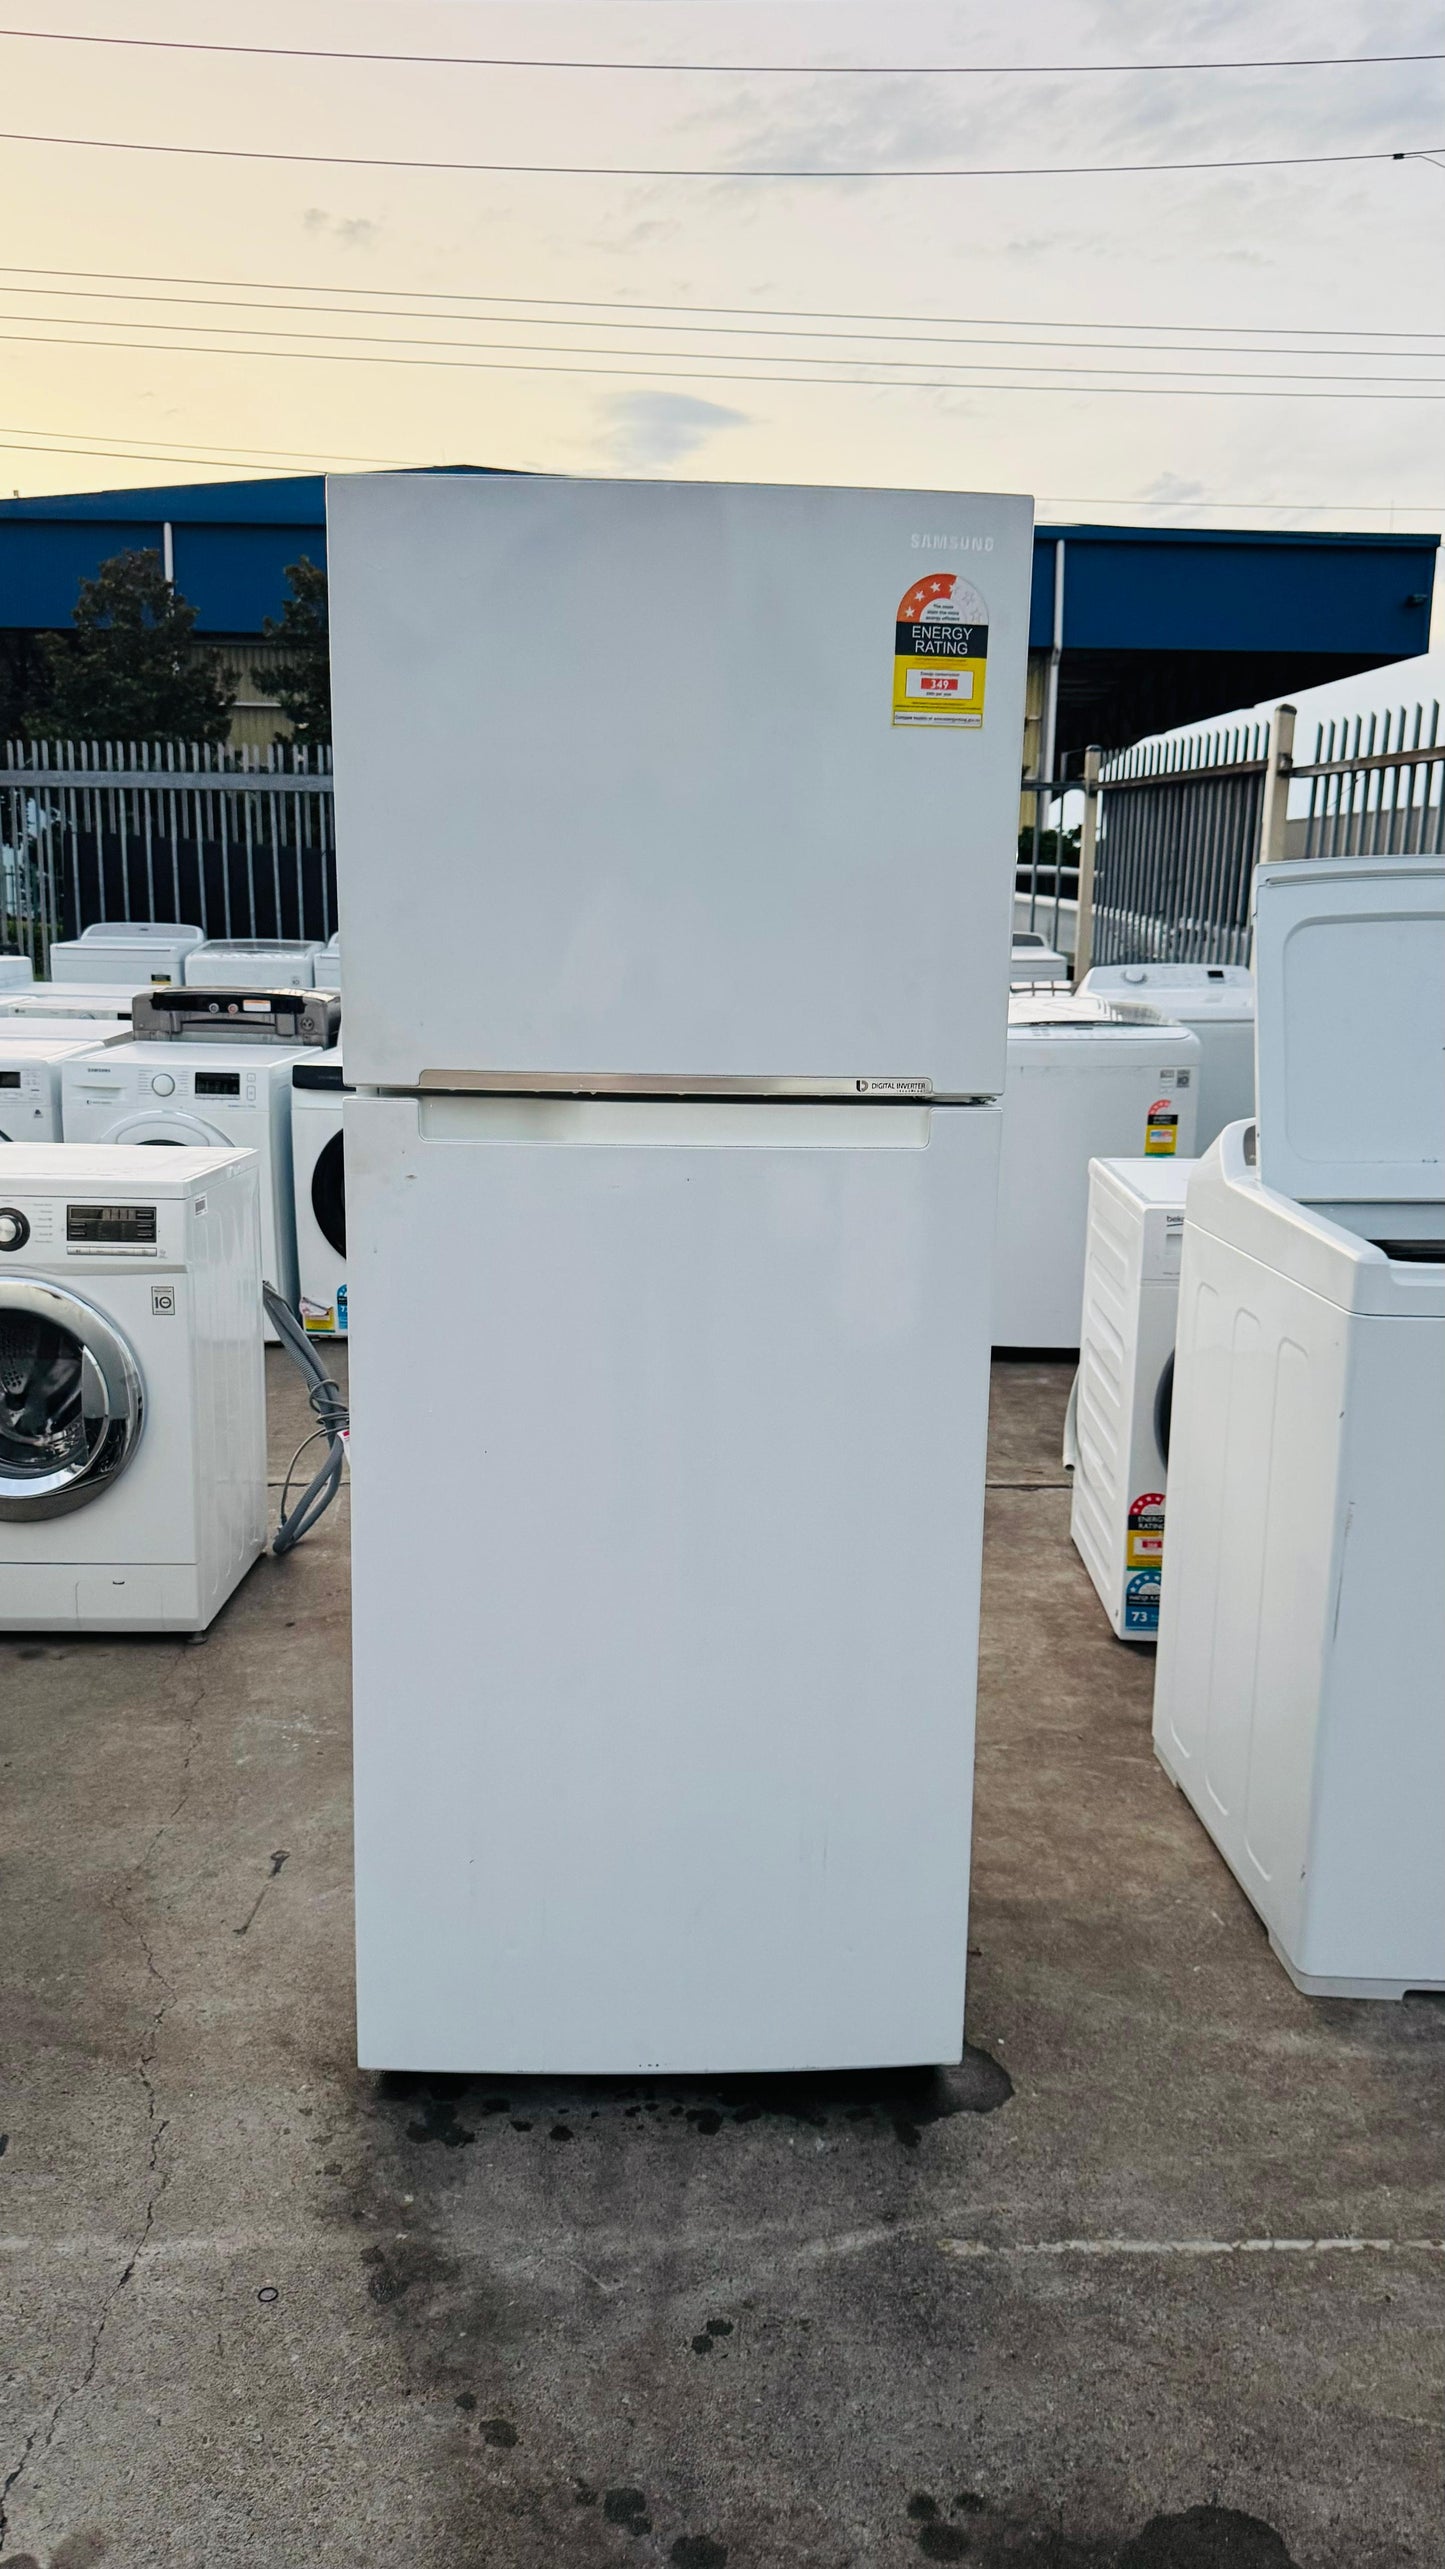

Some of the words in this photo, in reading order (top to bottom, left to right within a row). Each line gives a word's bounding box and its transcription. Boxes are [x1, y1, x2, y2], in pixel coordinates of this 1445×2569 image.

[911, 533, 994, 552] SAMSUNG
[912, 625, 973, 641] ENERGY
[915, 640, 968, 655] RATING
[930, 679, 949, 689] 349
[896, 1082, 926, 1090] INVERTER
[1131, 1611, 1148, 1622] 73
